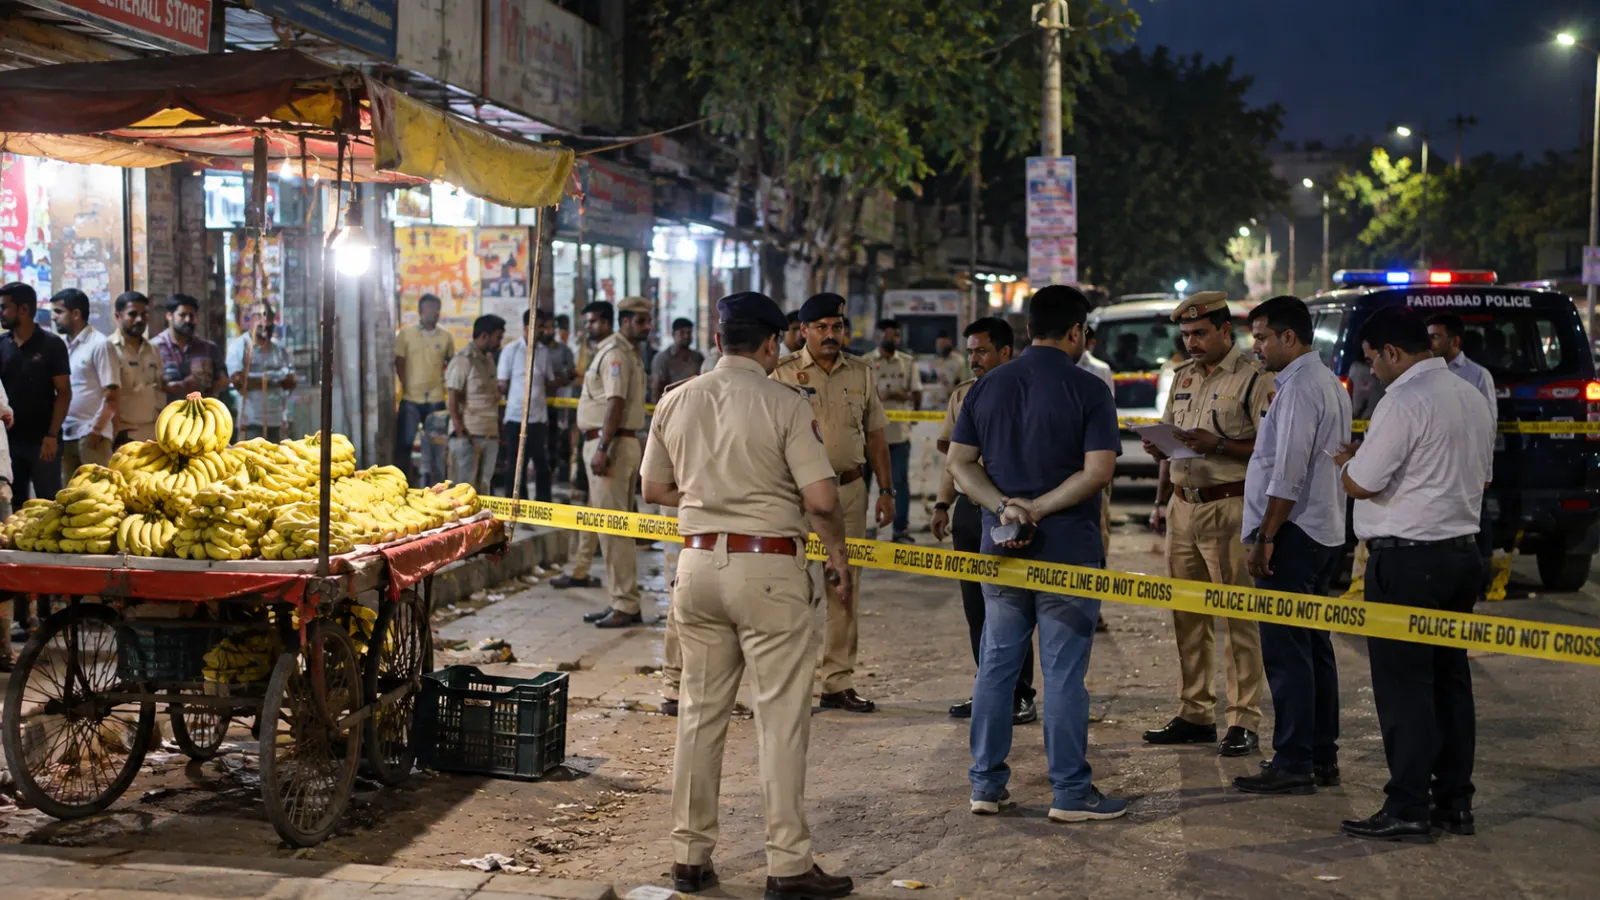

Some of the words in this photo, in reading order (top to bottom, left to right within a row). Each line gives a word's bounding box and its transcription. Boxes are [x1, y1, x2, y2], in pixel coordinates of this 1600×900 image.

[165, 0, 205, 38] STORE
[1406, 295, 1481, 307] FARIDABAD
[1485, 295, 1532, 308] POLICE
[1070, 572, 1093, 591] LINE
[1113, 578, 1135, 597] NOT
[1137, 581, 1172, 601] CROSS
[1205, 589, 1245, 611] POLICE
[1247, 594, 1273, 615] LINE
[1276, 597, 1293, 617] DO
[1296, 601, 1322, 621] NOT
[1324, 604, 1366, 627] CROSS
[1408, 614, 1457, 639] POLICE
[1460, 620, 1492, 643] LINE
[1495, 625, 1516, 646] DO
[1519, 628, 1550, 651] NOT
[1554, 632, 1600, 657] CROSS
